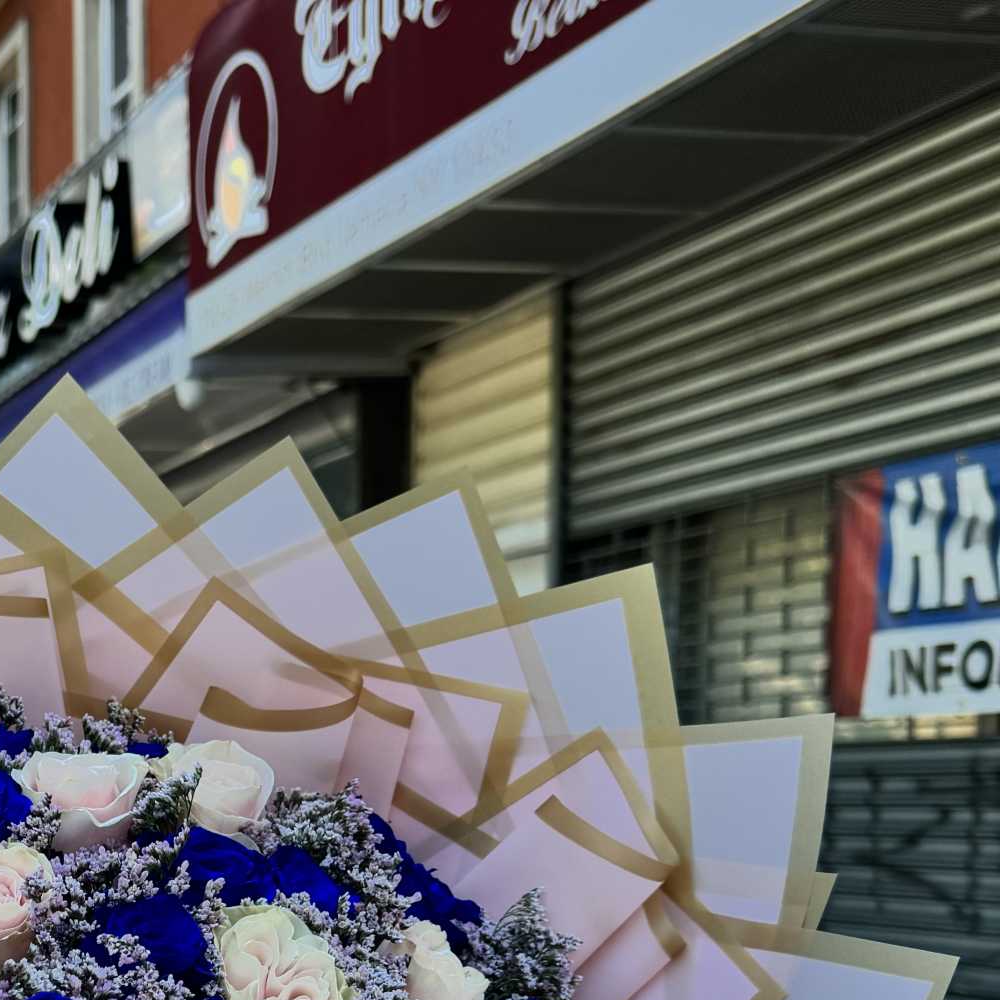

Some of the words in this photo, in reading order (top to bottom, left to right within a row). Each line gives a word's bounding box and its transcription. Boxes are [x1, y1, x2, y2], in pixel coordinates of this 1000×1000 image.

[17, 153, 119, 344] Deli
[887, 463, 1000, 614] HA
[889, 639, 1000, 697] INFO
